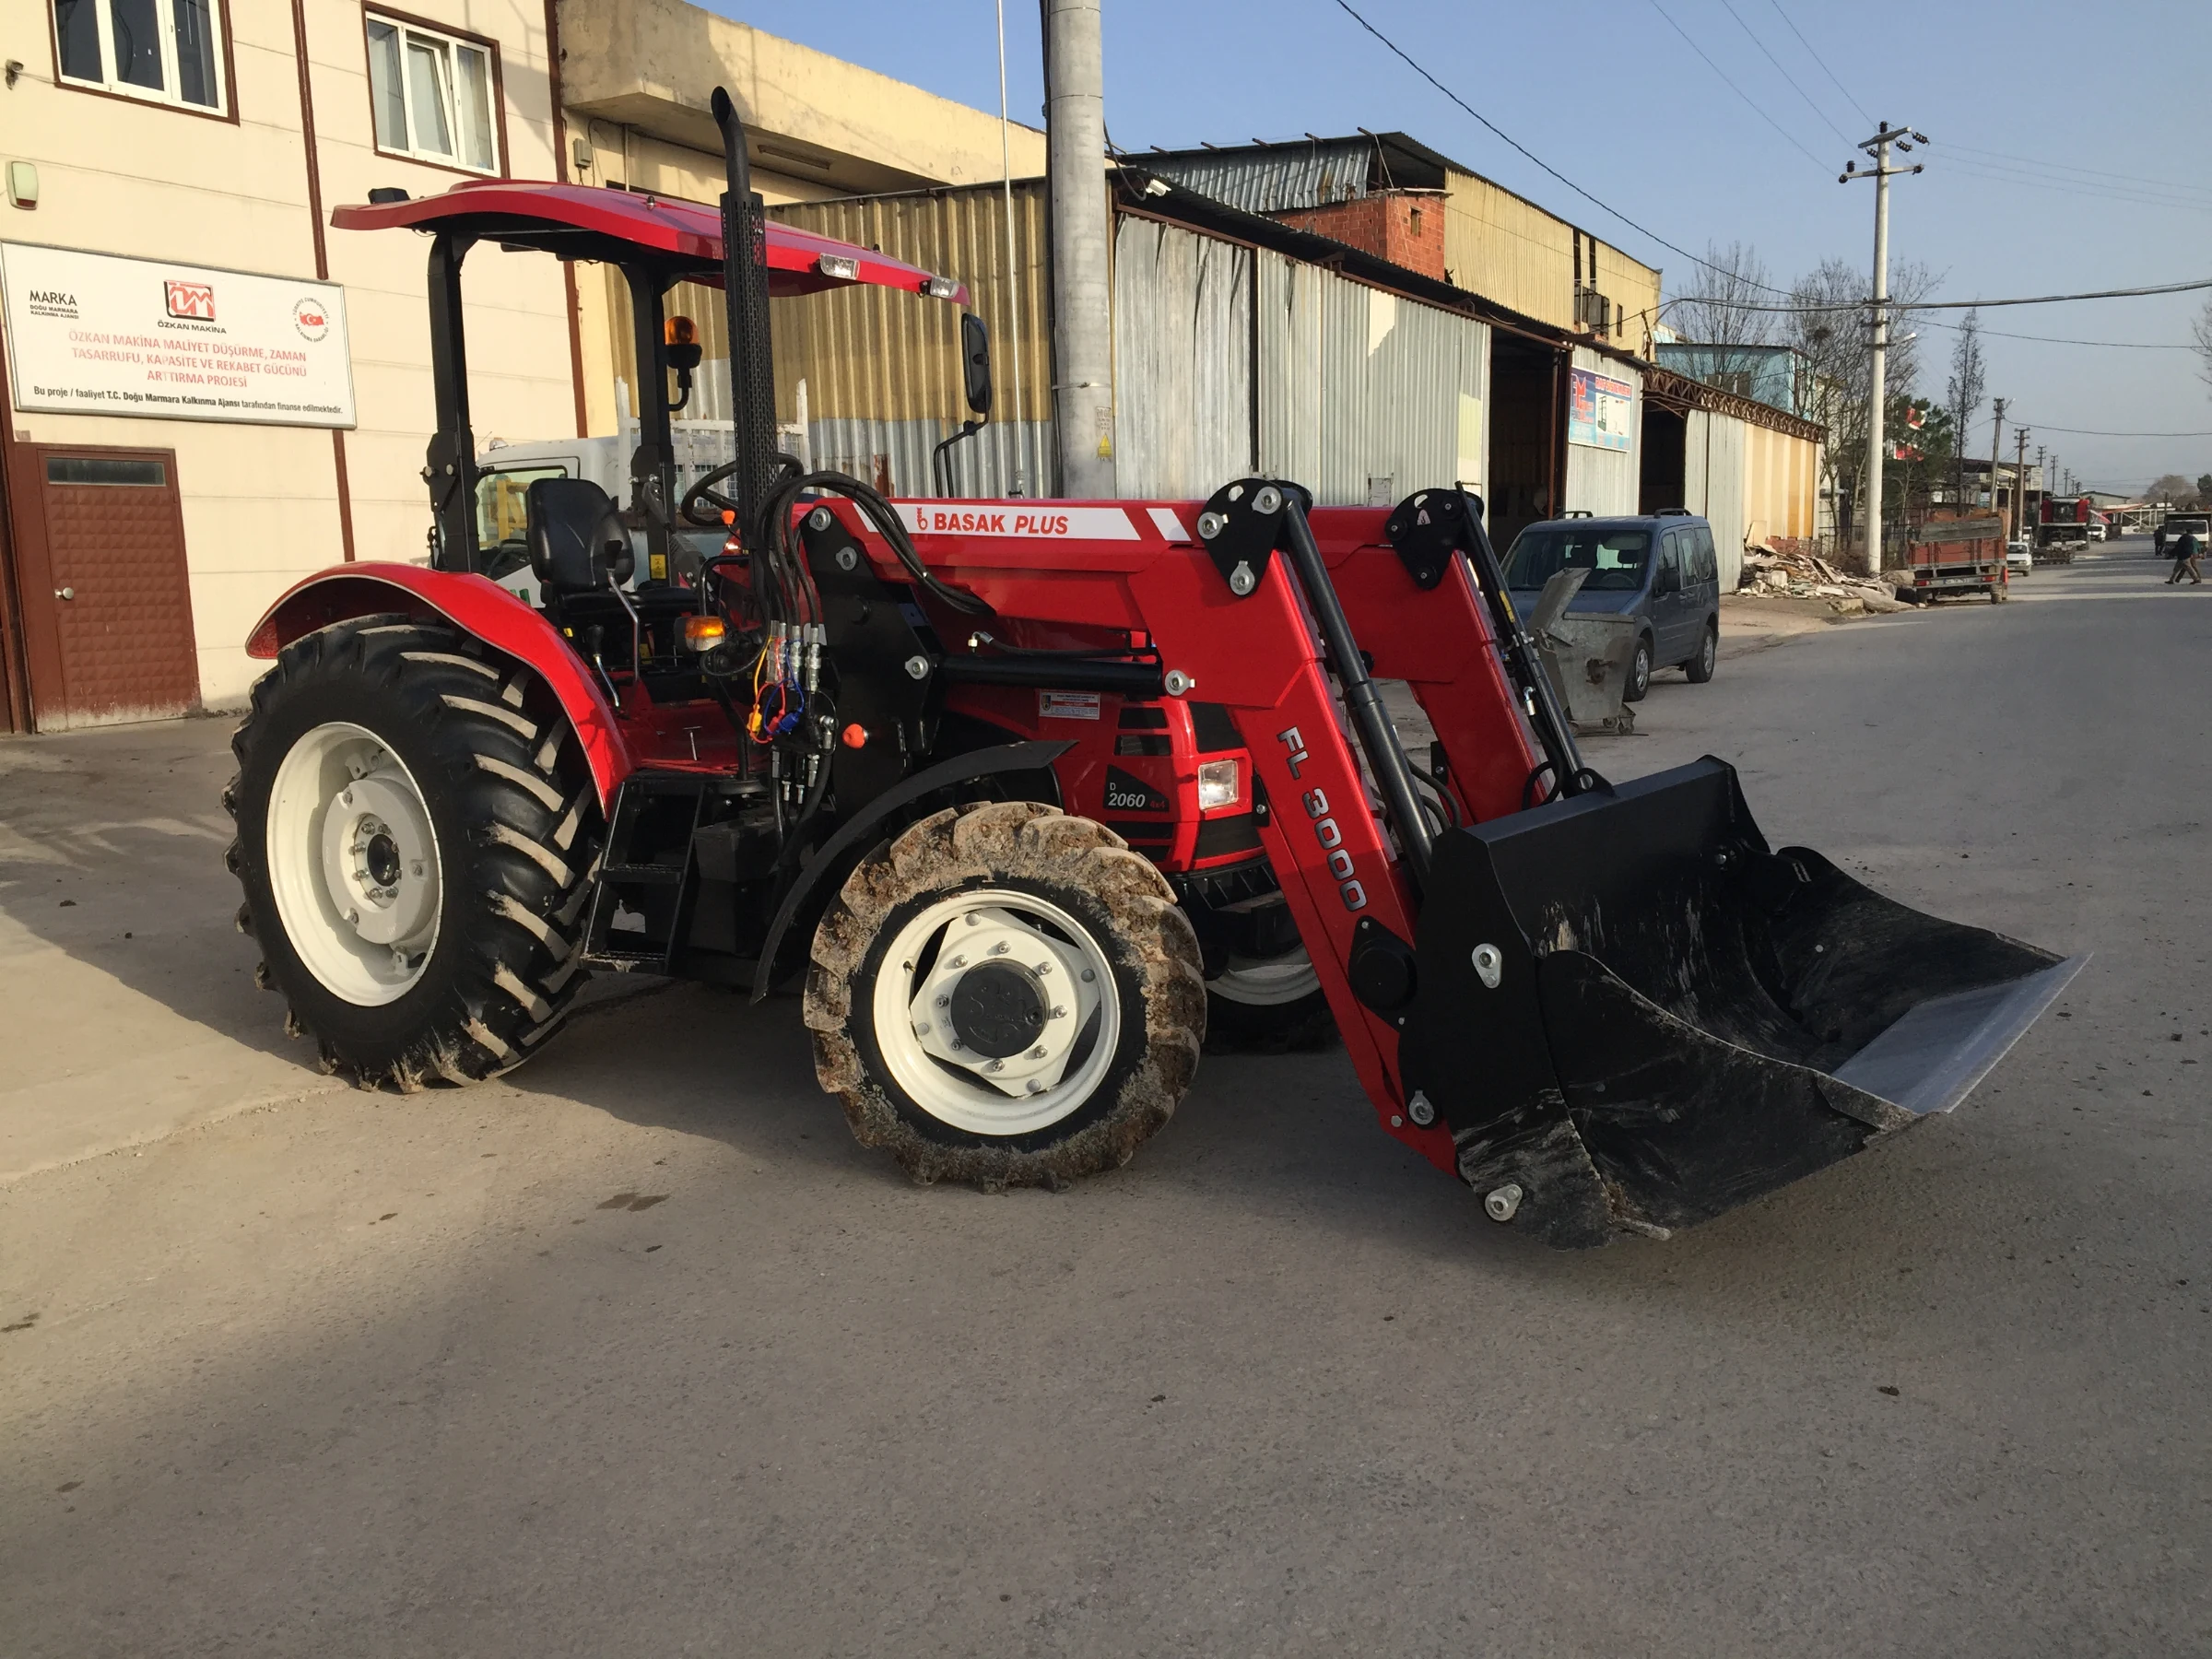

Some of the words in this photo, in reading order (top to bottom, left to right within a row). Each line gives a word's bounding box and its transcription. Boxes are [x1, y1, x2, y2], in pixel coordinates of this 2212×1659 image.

[29, 289, 77, 306] MARKA
[48, 306, 78, 314] MARMARA
[158, 319, 190, 331] ÖZKAN
[191, 324, 227, 335] MAKİNA
[68, 328, 110, 345] ÖZKAN
[112, 335, 160, 349] MAKİNA
[163, 339, 209, 353] MALİYET
[213, 342, 267, 359] DÜŞÜRME,
[270, 349, 307, 361] ZAMAN
[71, 347, 144, 365] TASARRUFU,
[147, 353, 197, 368] KAPASİTE
[200, 358, 214, 370] VE
[217, 359, 261, 373] REKABET
[264, 362, 307, 377] GÜCÜNÜ
[147, 370, 205, 384] ARTTIRMA
[206, 375, 247, 387] PROJESİ
[34, 385, 45, 395] Bu
[47, 387, 68, 398] proje
[76, 388, 105, 400] faaliyet
[106, 391, 121, 400] T.C.
[123, 392, 144, 403] Doğu
[145, 394, 180, 404] Marmara
[182, 395, 217, 406] Kalkınma
[218, 398, 241, 408] Ajansı
[241, 400, 276, 410] tarafından
[277, 402, 301, 411] finanse
[302, 404, 343, 414] edilmektedir.
[934, 512, 1006, 533] BASAK
[1014, 515, 1069, 535] PLUS
[1109, 782, 1116, 791] D
[1108, 793, 1146, 807] 2060
[1149, 800, 1165, 808] 4x4
[1277, 725, 1309, 781] FL
[1301, 787, 1368, 912] 3000
